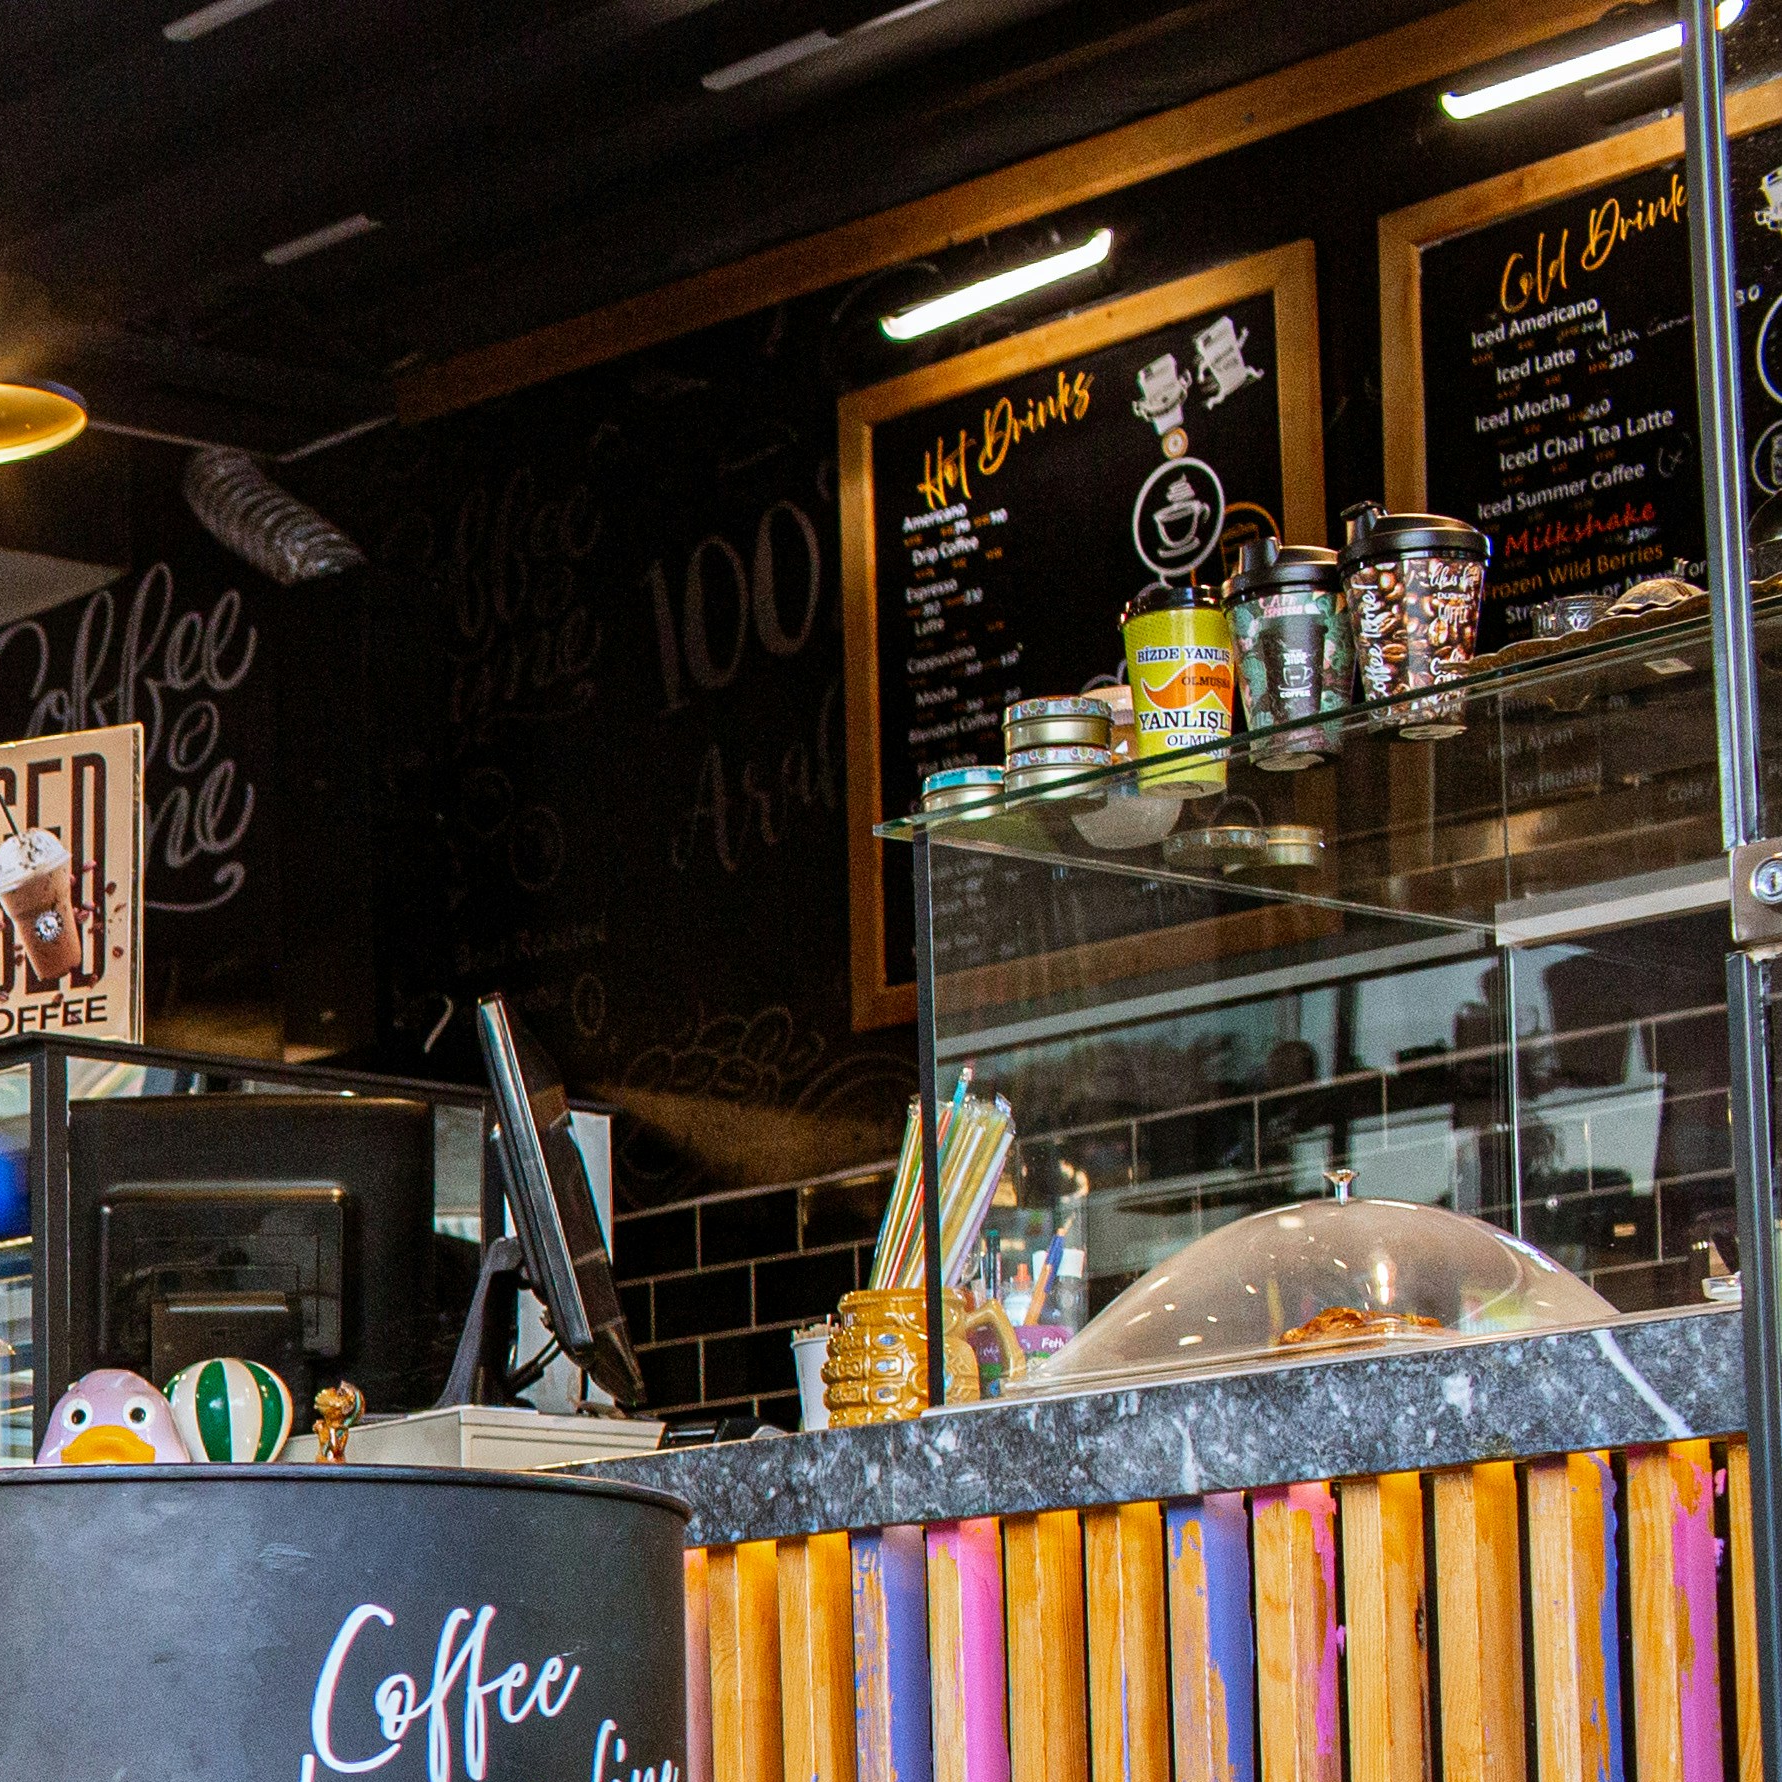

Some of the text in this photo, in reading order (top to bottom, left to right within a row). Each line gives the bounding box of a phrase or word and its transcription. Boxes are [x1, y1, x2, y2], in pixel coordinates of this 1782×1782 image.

[1499, 174, 1689, 313] Cold Drink
[1471, 298, 1599, 348] Iced Americano
[1496, 358, 1532, 385] Iced
[1535, 348, 1576, 373] Latte
[1476, 392, 1572, 433] Iced Mocha
[917, 370, 1094, 508] Hot Drinks
[1499, 409, 1675, 472] Iced Chai Tea Latte
[902, 502, 968, 532] Americano
[1477, 494, 1513, 520] Iced
[1515, 478, 1587, 512] Summer
[939, 536, 979, 559] Coffee
[1505, 502, 1656, 557] Milkshake
[1549, 561, 1591, 585] Wild
[1598, 544, 1663, 574] Berries
[1138, 647, 1179, 662] BİZDE
[1280, 690, 1311, 698] COFFEE
